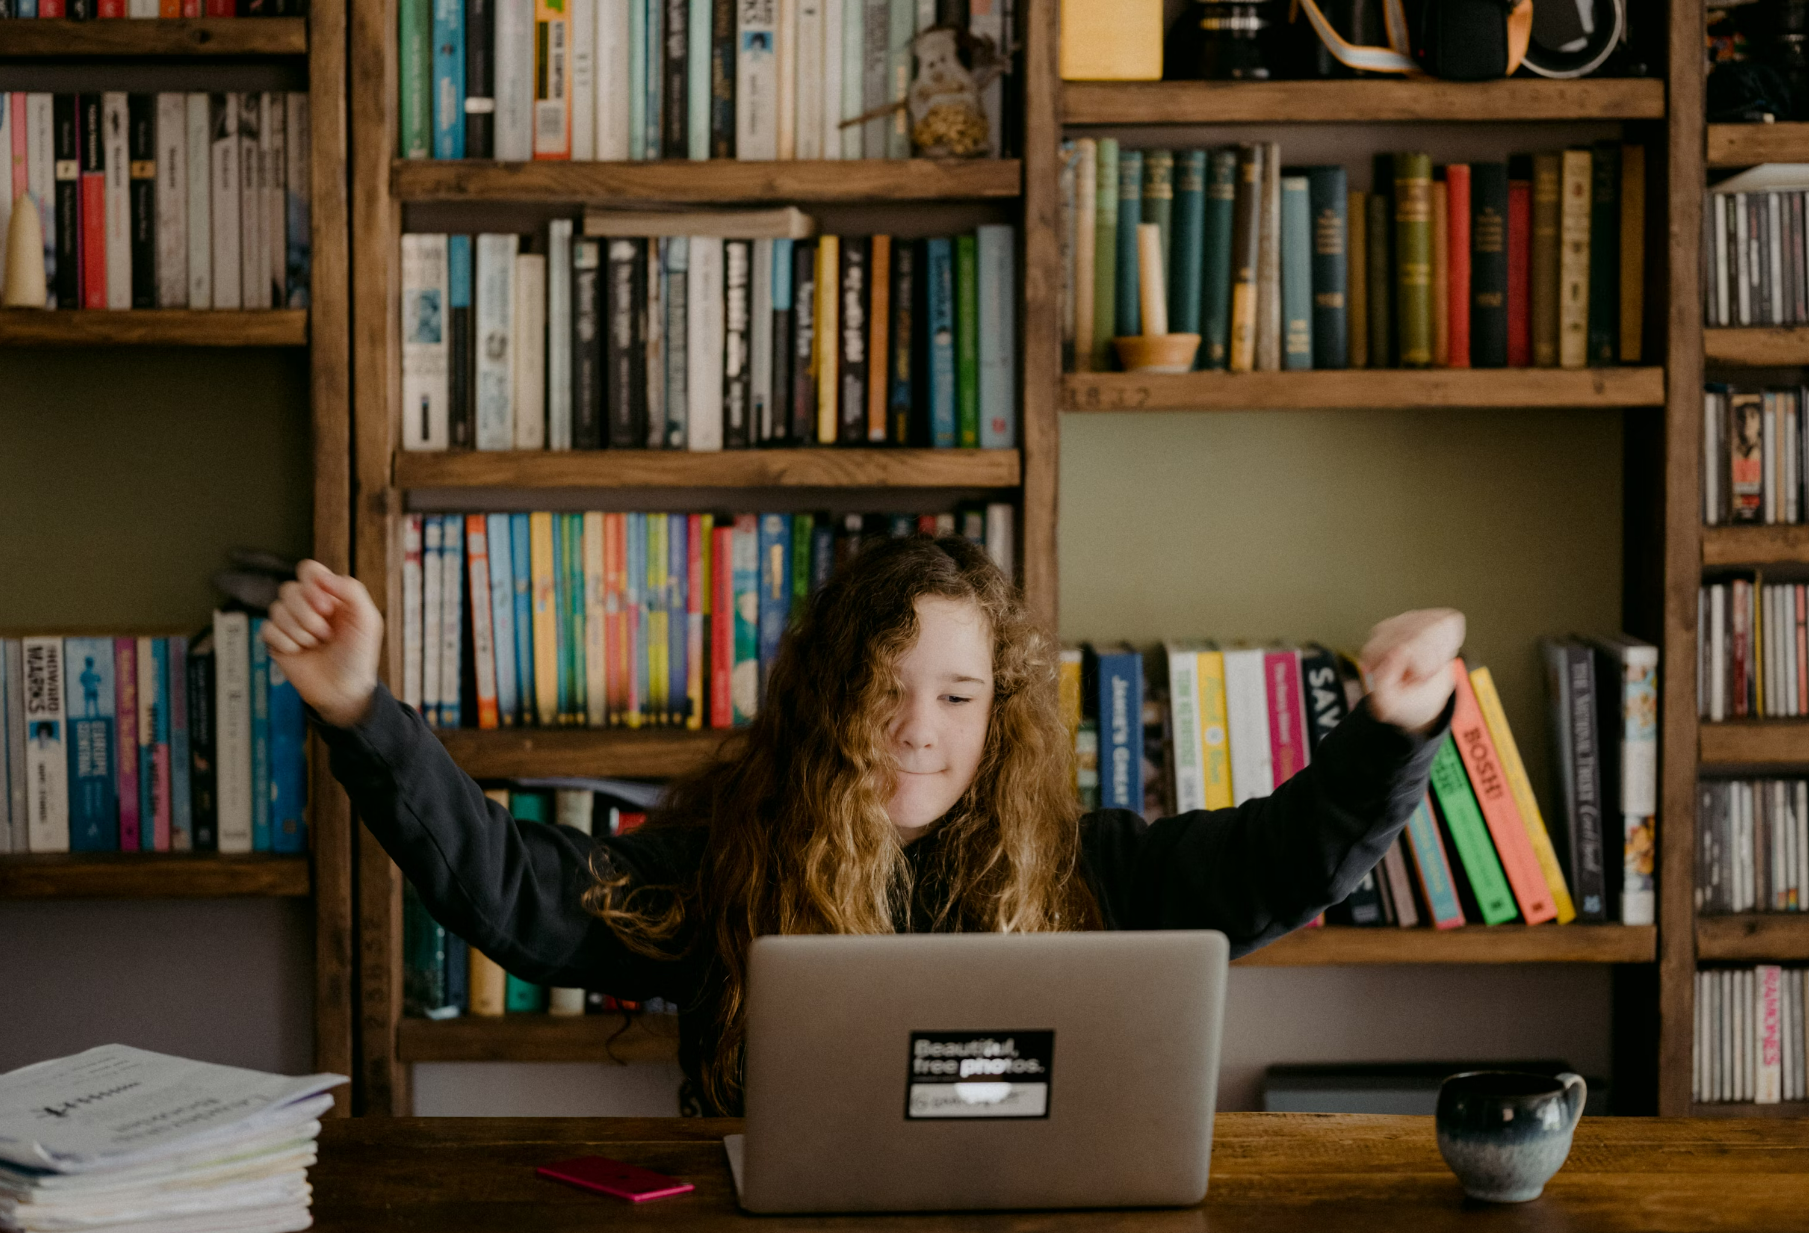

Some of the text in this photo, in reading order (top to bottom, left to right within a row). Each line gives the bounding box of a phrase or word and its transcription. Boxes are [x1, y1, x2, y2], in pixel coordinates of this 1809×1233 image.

[27, 645, 46, 714] MARKS
[1308, 666, 1343, 744] SAV
[1112, 746, 1131, 805] GREAT
[1463, 726, 1504, 800] BOSH!
[1576, 756, 1595, 801] TRUST
[1763, 966, 1780, 1068] RAMONES
